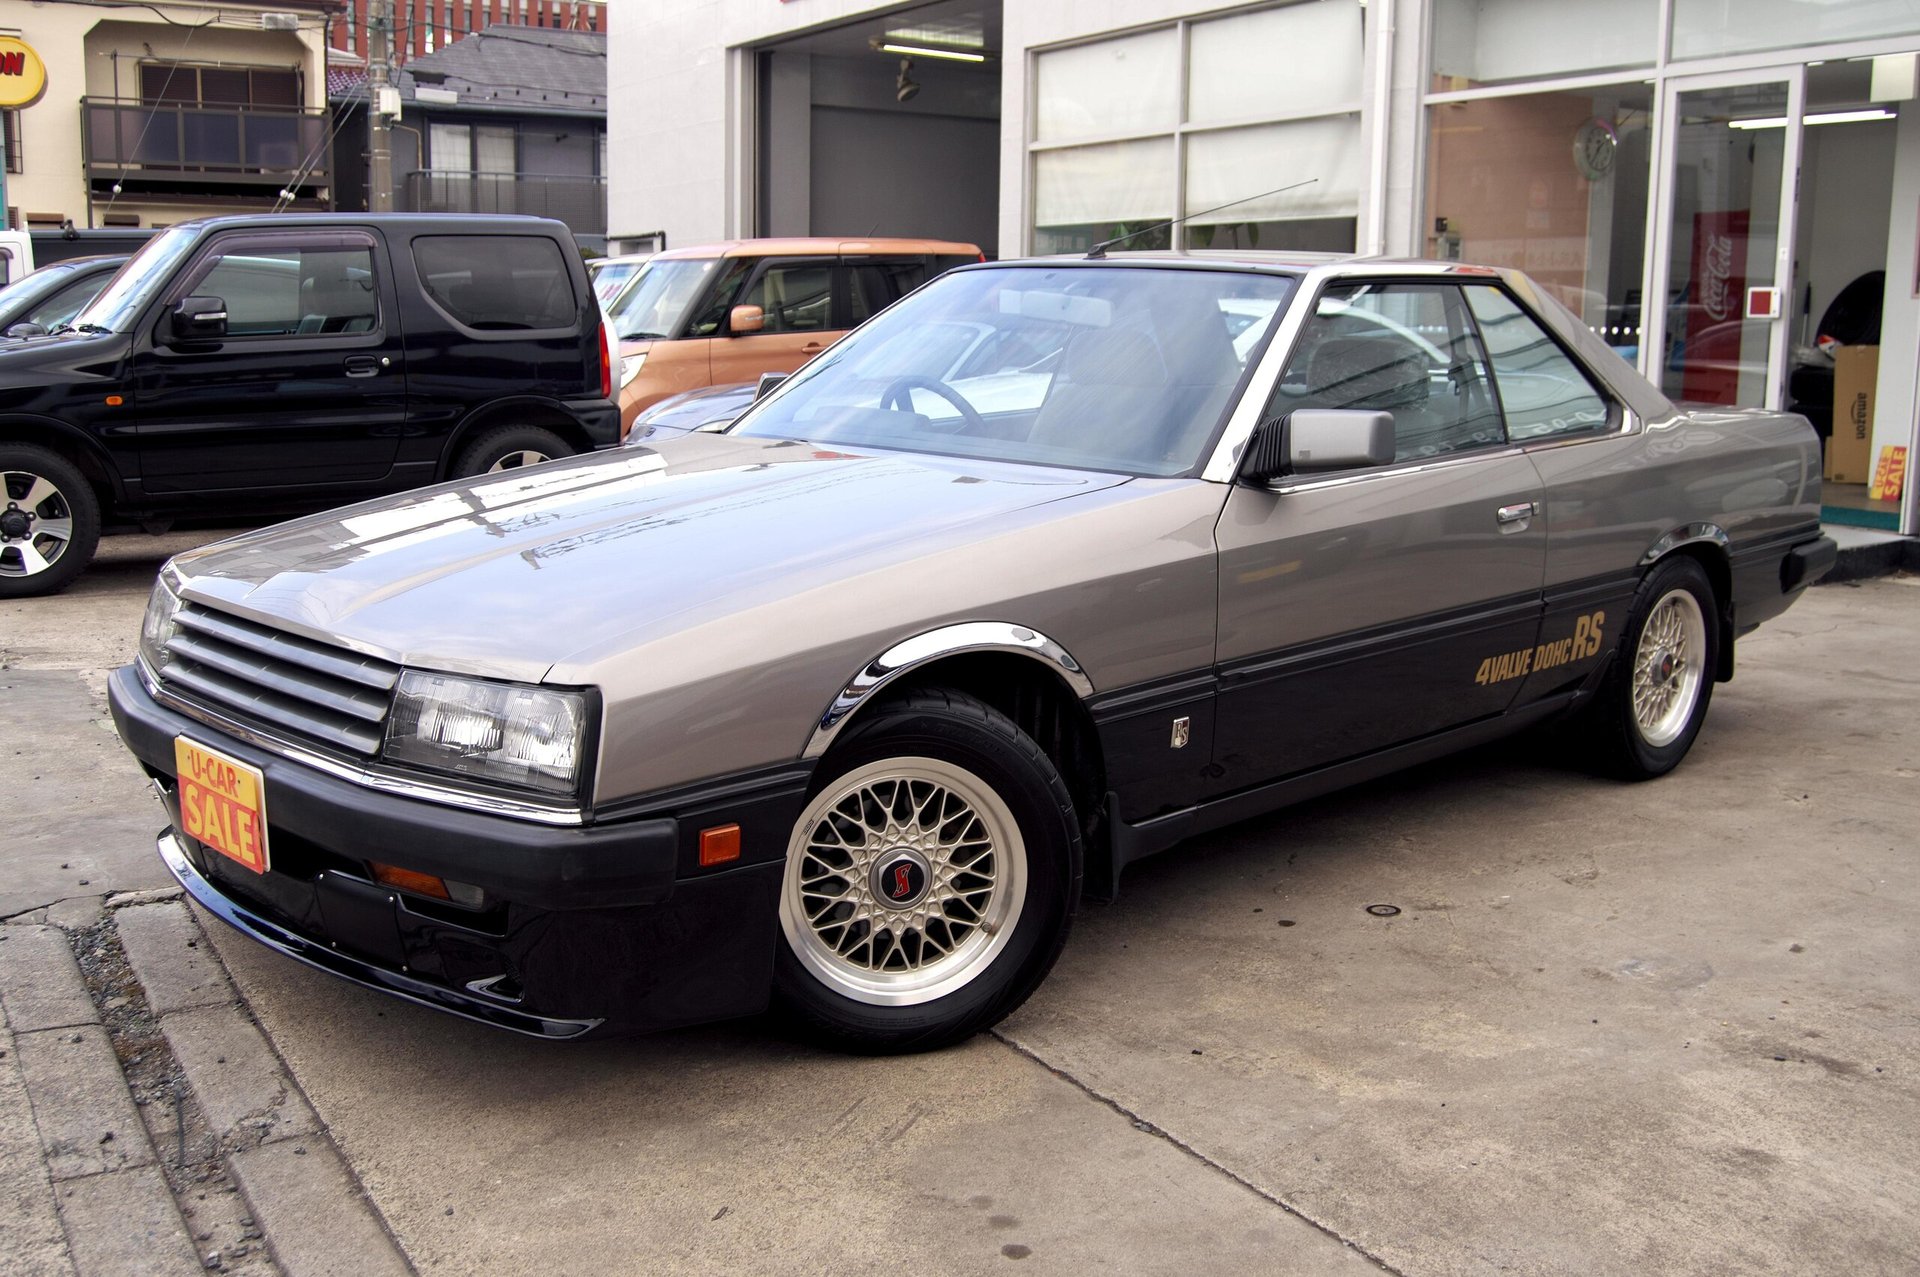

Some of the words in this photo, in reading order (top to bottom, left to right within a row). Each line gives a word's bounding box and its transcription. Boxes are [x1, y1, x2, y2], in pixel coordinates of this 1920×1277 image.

[1856, 392, 1867, 440] amazon
[1885, 448, 1905, 496] SALE
[1532, 638, 1572, 673] DOHC
[1570, 611, 1605, 662] RS
[190, 749, 239, 798] U-CAR
[185, 783, 256, 865] SALE
